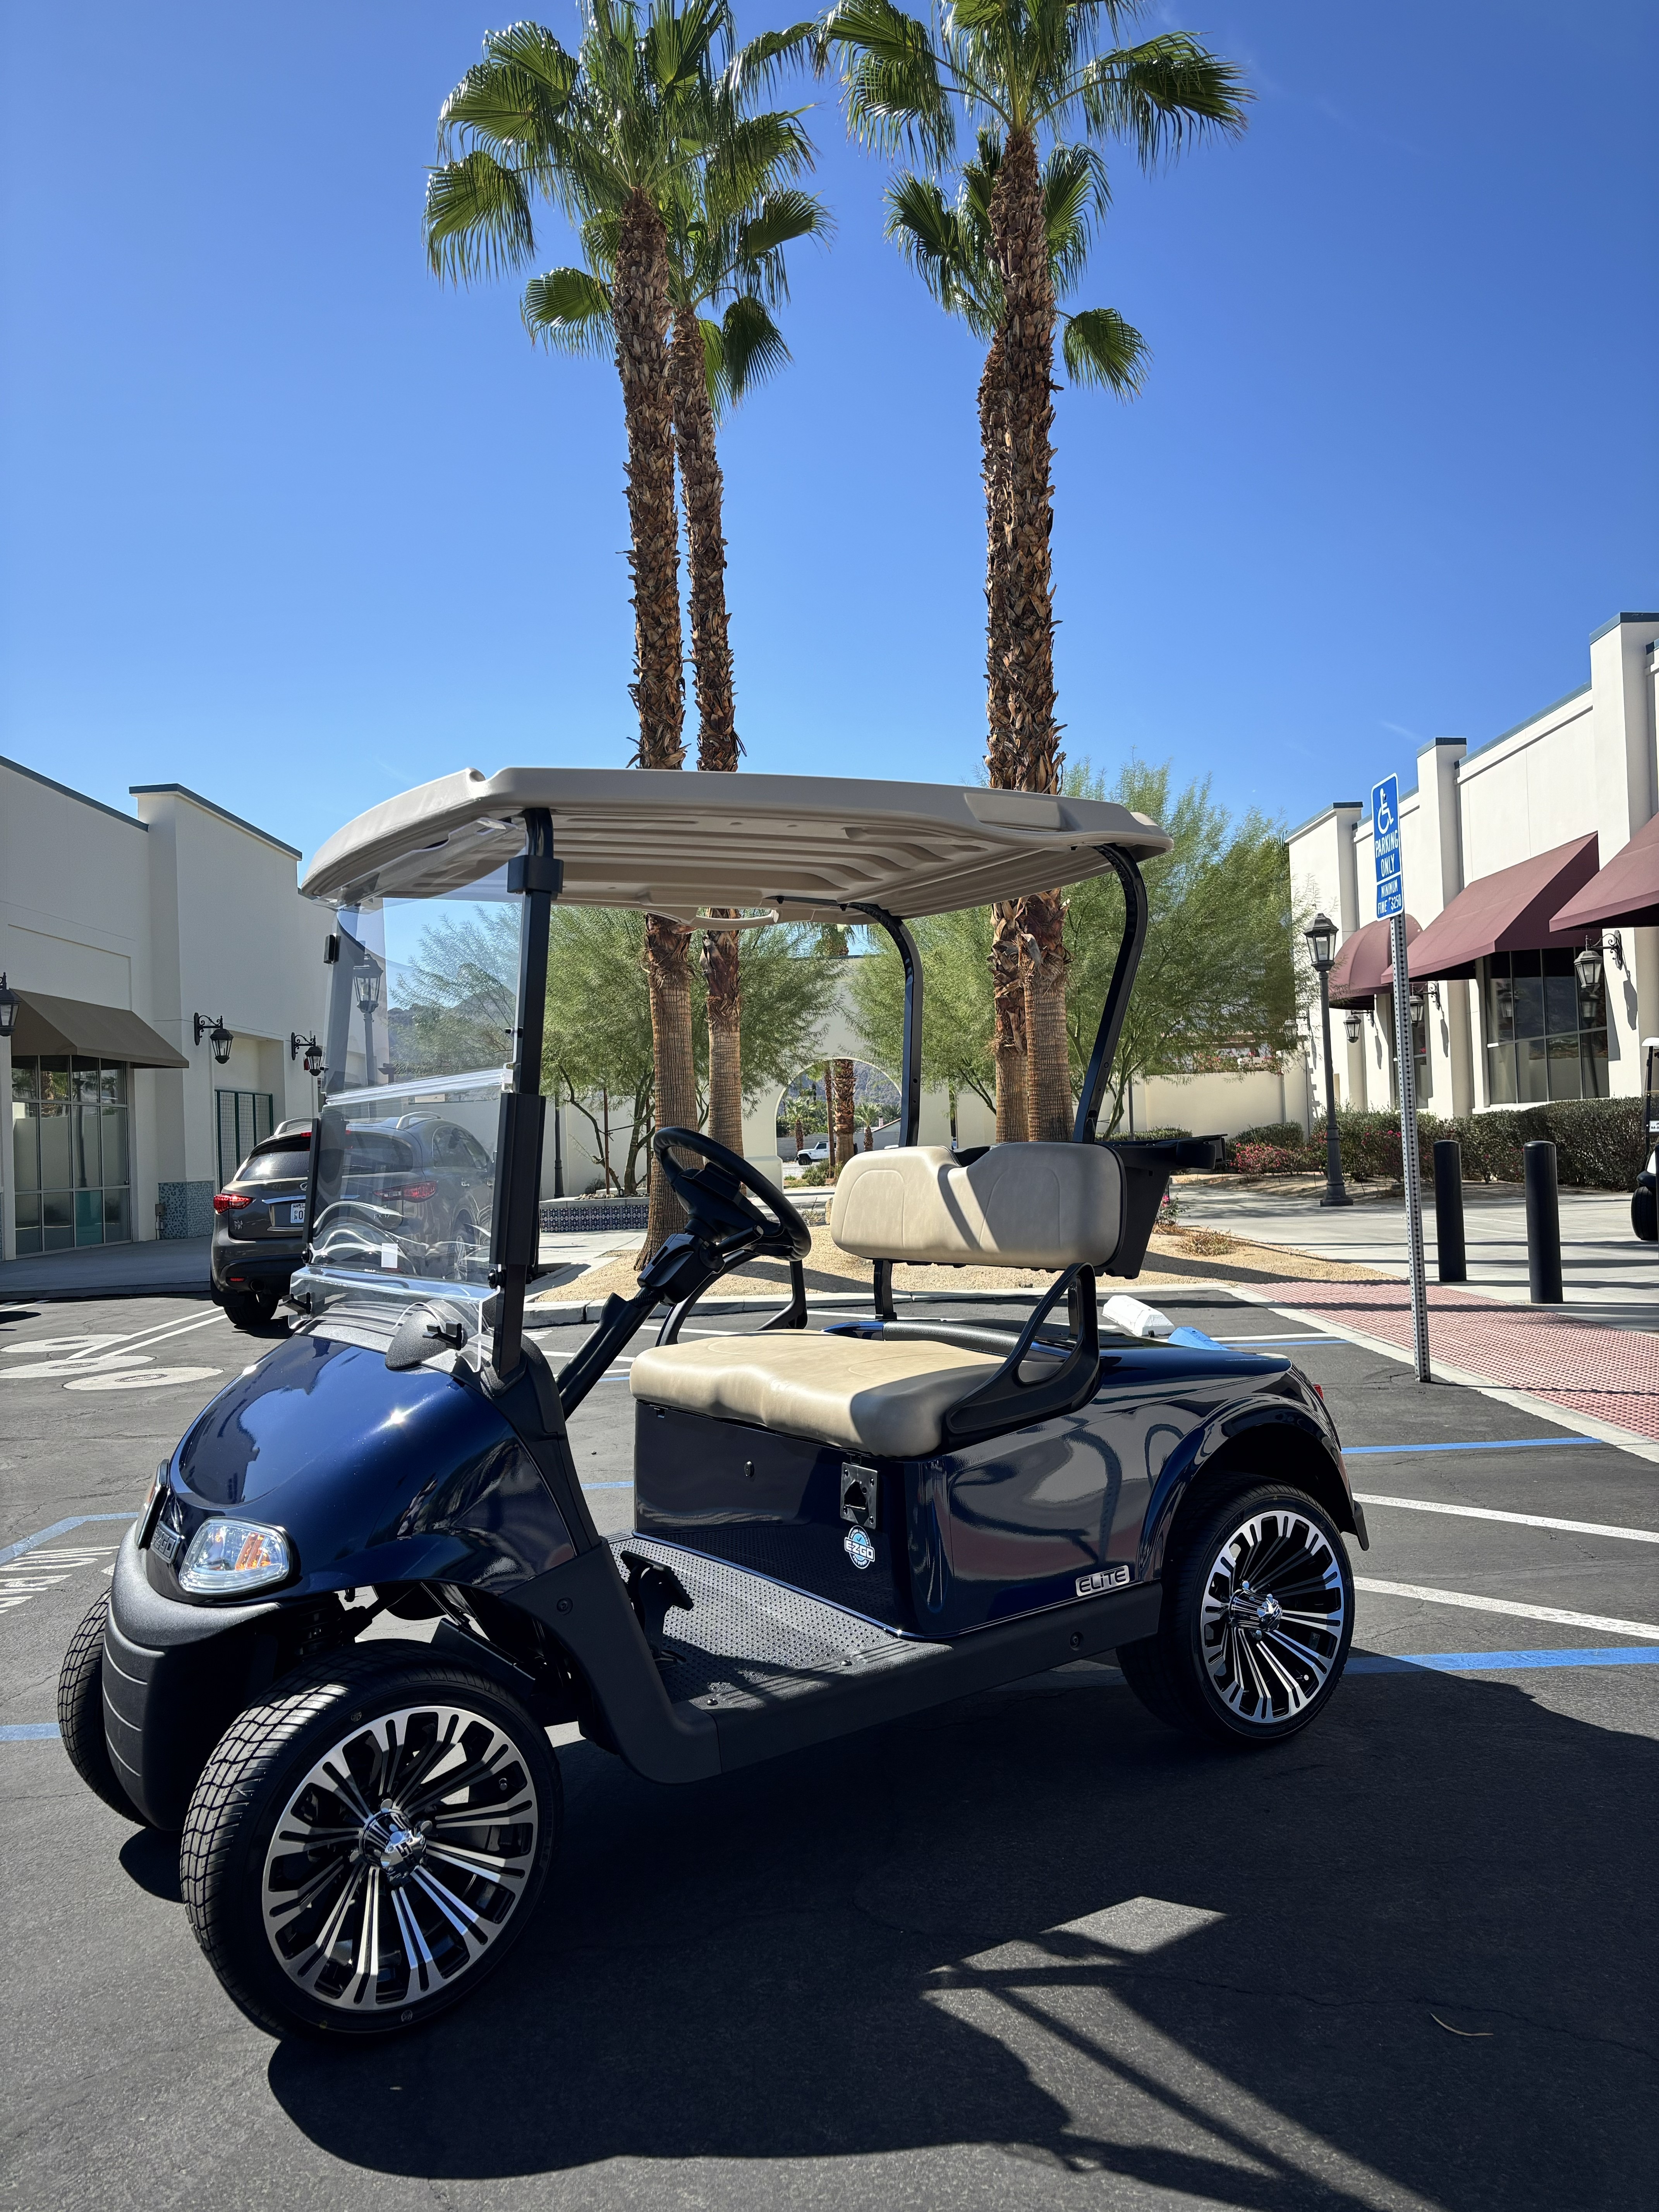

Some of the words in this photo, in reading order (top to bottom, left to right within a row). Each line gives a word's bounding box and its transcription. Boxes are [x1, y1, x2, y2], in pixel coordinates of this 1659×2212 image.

[1376, 830, 1398, 858] PARKING
[1381, 854, 1395, 878] ONLY
[1381, 879, 1398, 898] MINIMUM
[1378, 901, 1387, 915] FINE
[1221, 1514, 1241, 1539] RADIAL
[846, 1539, 874, 1560] EZGO
